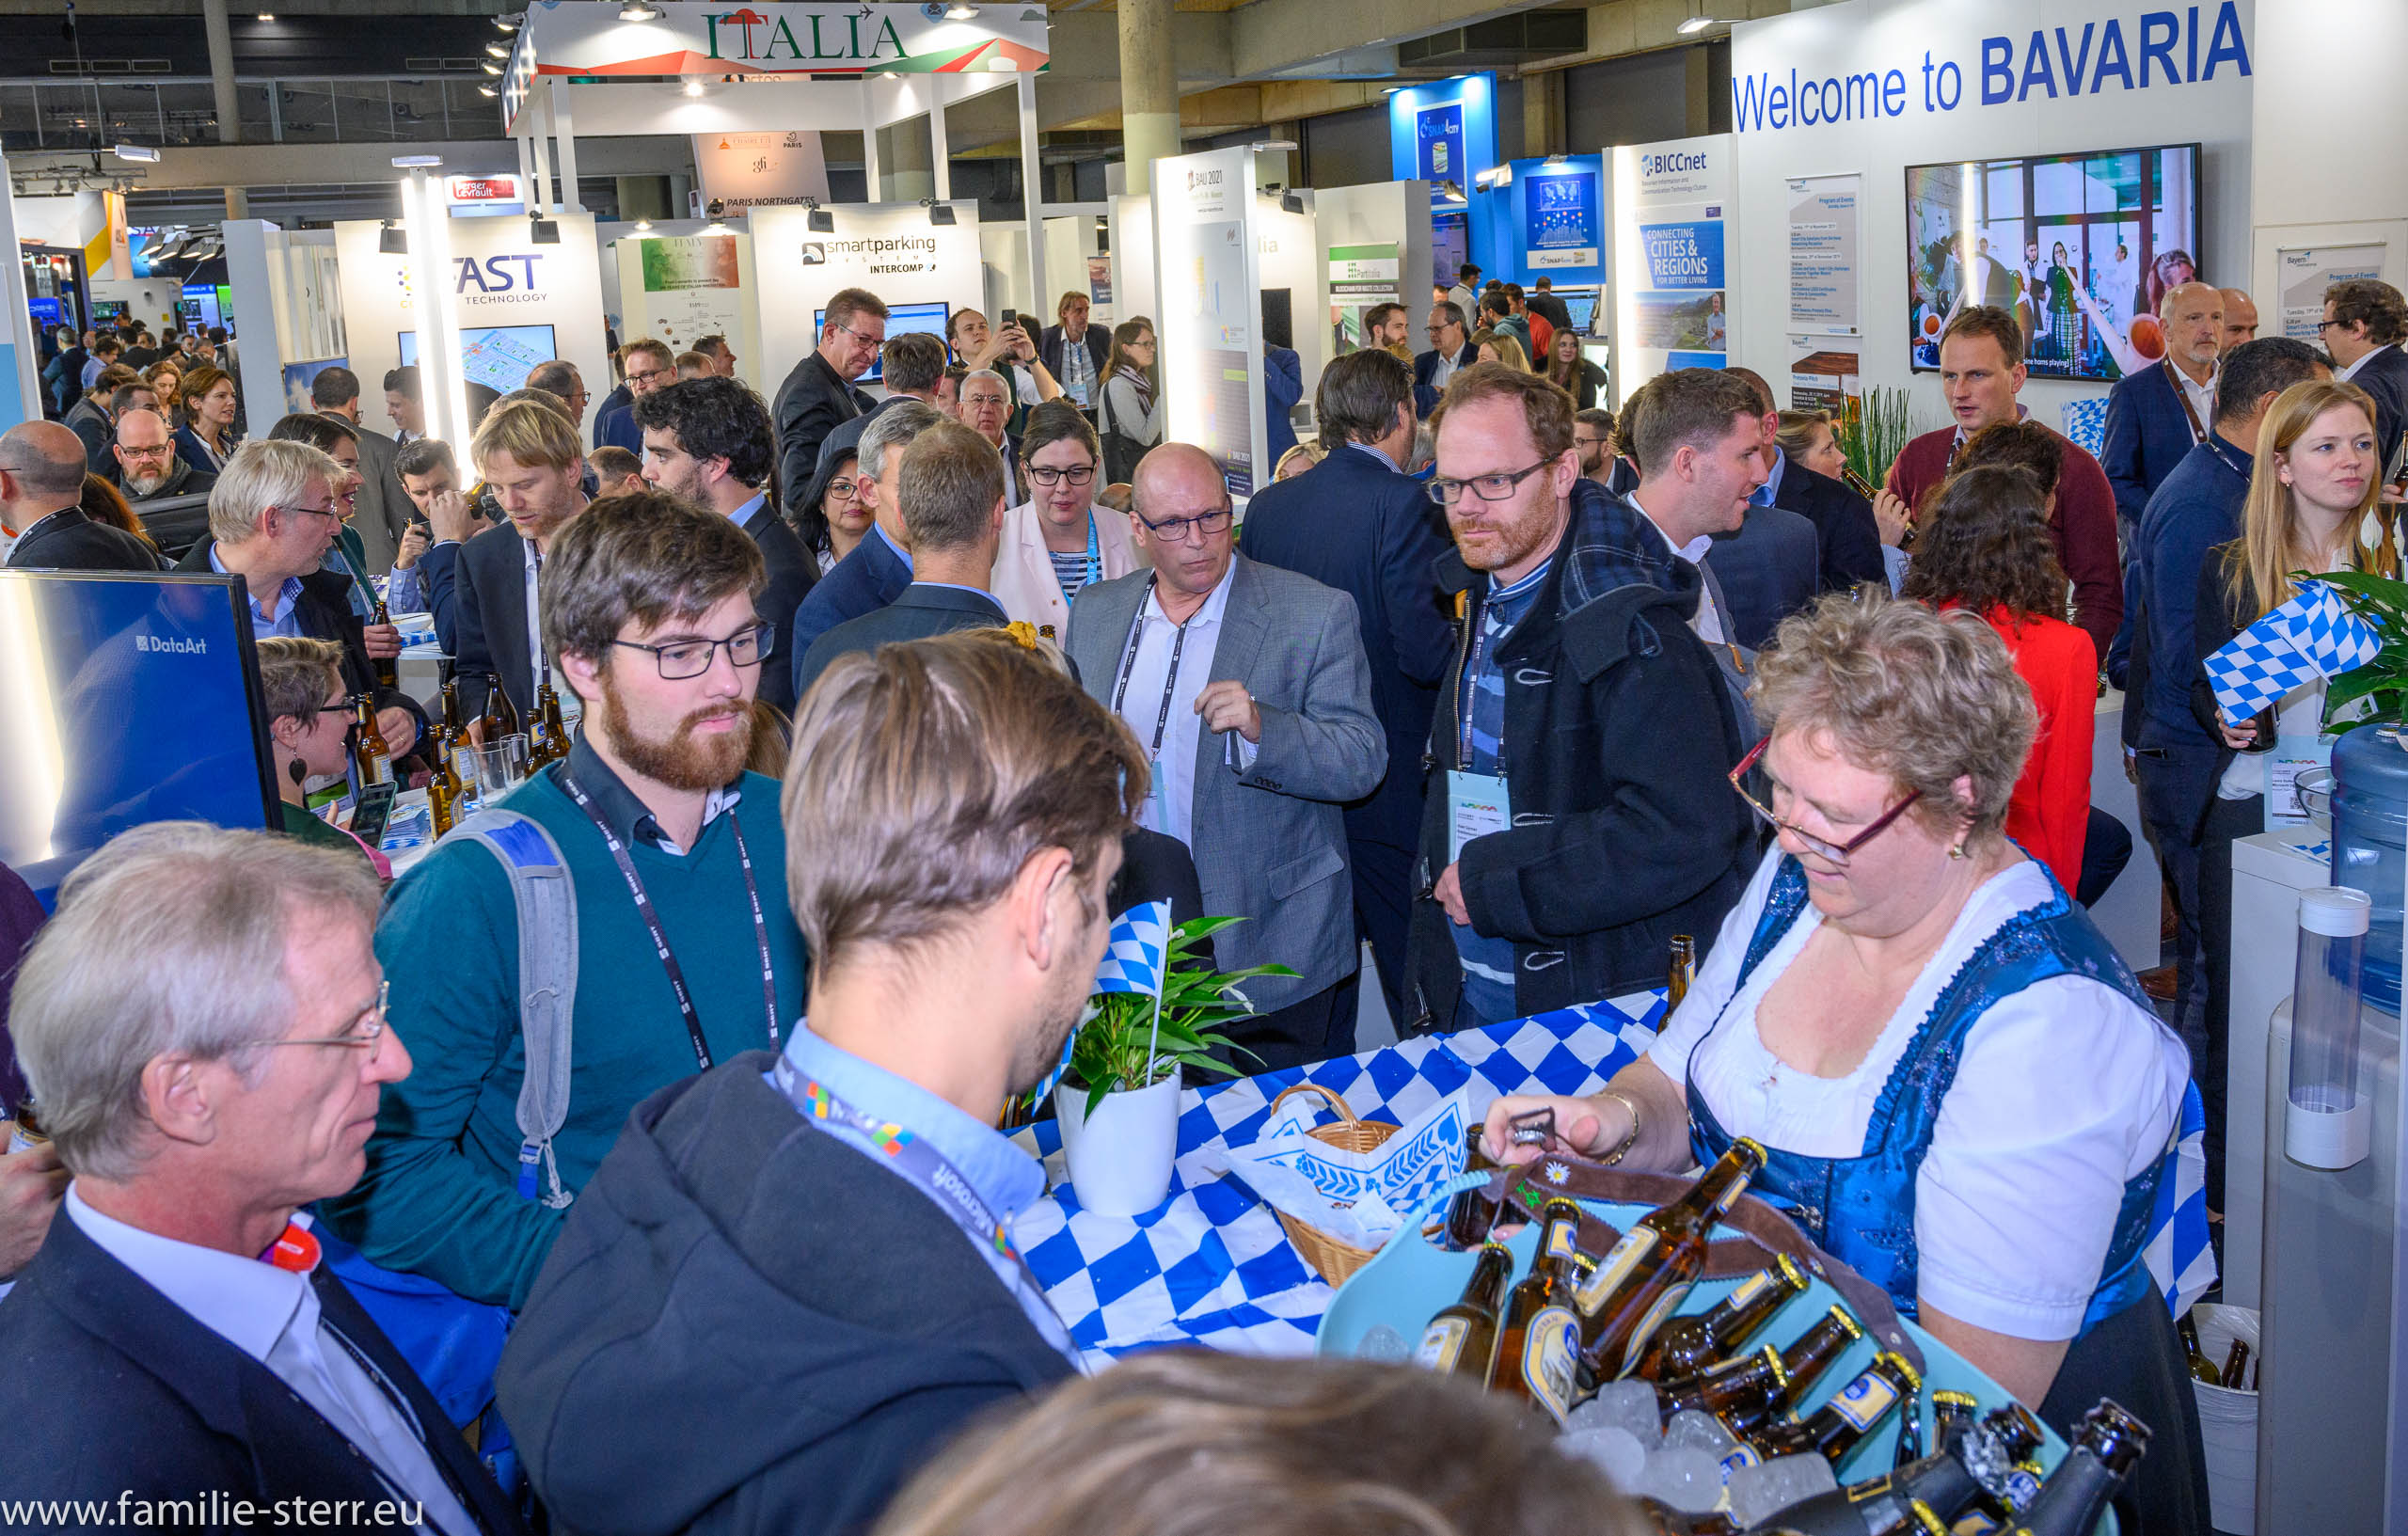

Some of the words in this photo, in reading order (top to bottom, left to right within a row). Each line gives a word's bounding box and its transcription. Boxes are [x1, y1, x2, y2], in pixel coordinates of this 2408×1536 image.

[700, 12, 909, 60] ITALIA
[1733, 68, 1906, 131] Welcome
[1922, 50, 1962, 112] to
[1981, 1, 2252, 105] BAVARIA
[1655, 151, 1707, 174] BICCnet
[1209, 169, 1223, 184] 2021
[727, 198, 753, 208] PARIS
[1647, 228, 1694, 241] CONNECTING
[827, 235, 936, 254] smartparking
[1651, 240, 1686, 257] CITIES
[1687, 239, 1698, 257] &
[870, 263, 924, 275] INTERCOMP
[1655, 257, 1708, 276] REGIONS
[1668, 276, 1687, 284] BETTER
[1688, 276, 1708, 284] LIVING
[466, 293, 547, 305] TECHNOLOGY
[150, 636, 207, 655] DataArt
[932, 1162, 995, 1238] Microsoft
